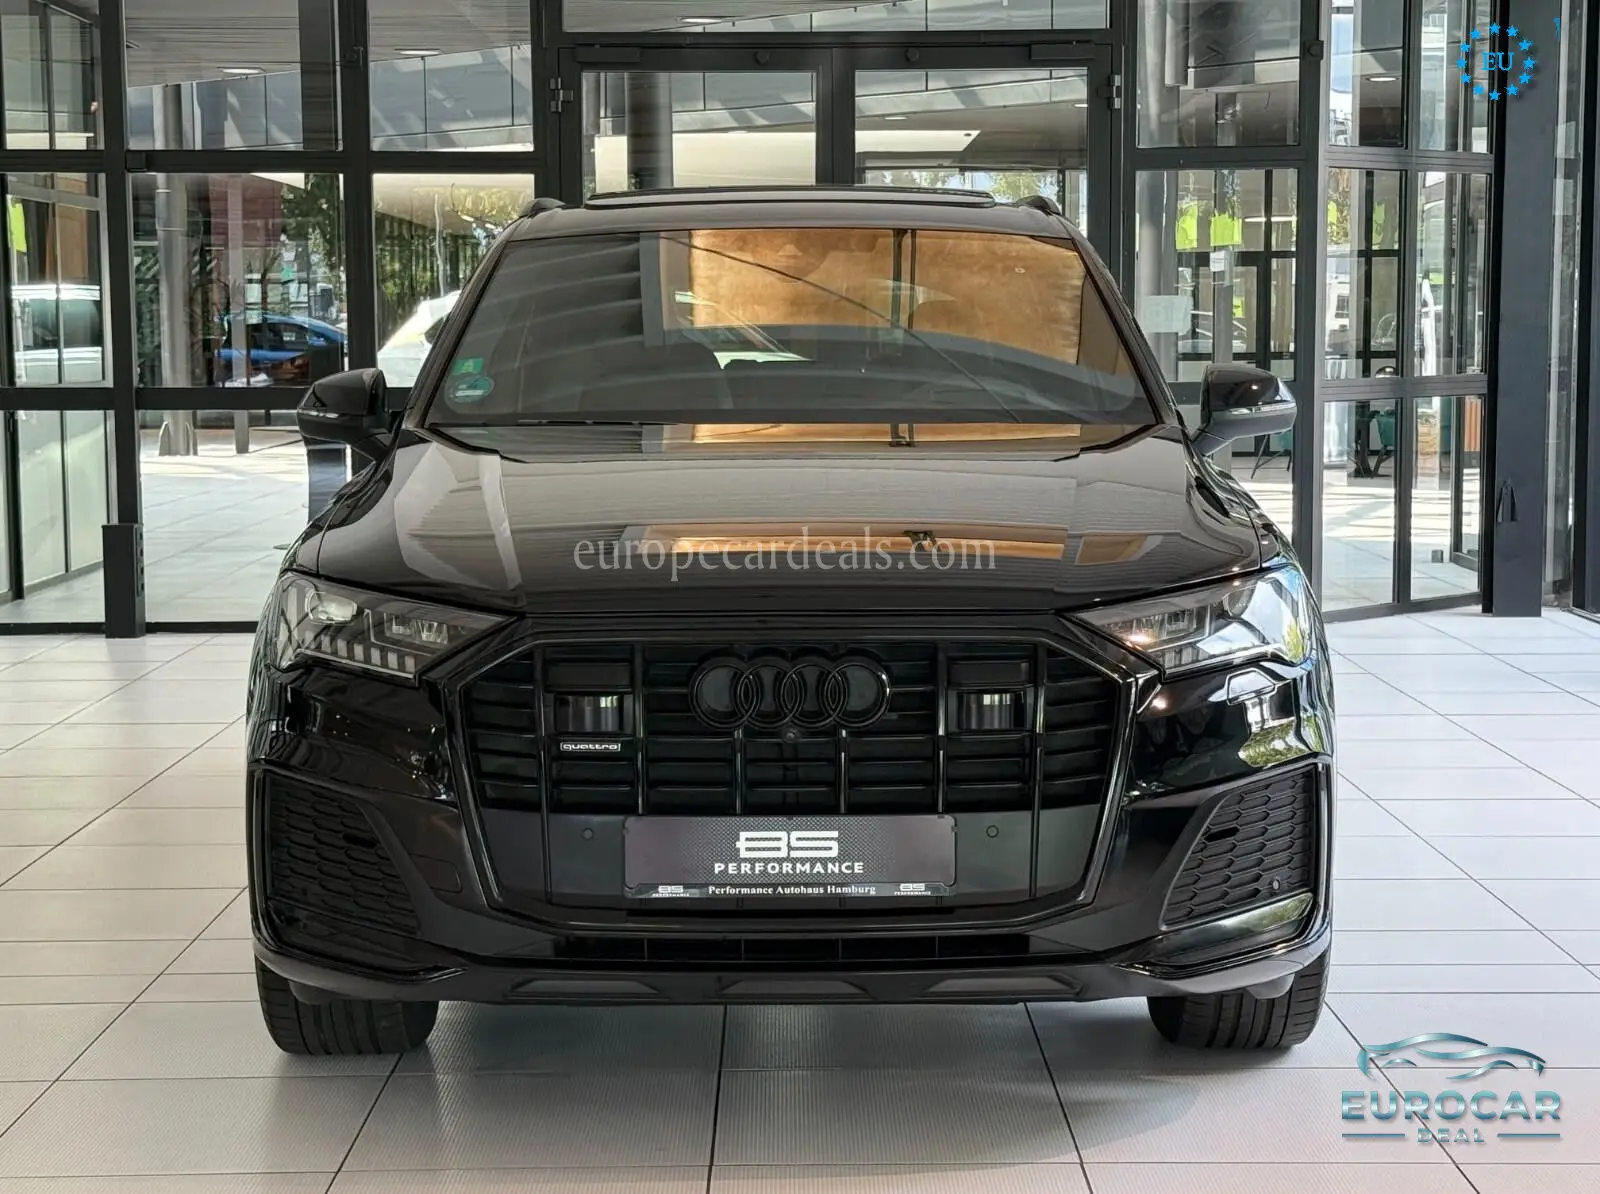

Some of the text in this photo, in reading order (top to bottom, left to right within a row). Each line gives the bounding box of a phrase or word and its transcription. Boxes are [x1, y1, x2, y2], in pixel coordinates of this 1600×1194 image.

[562, 743, 618, 751] quattro
[714, 862, 864, 875] PERFORMANCE
[708, 885, 876, 895] Performance Autohaus Hamburg
